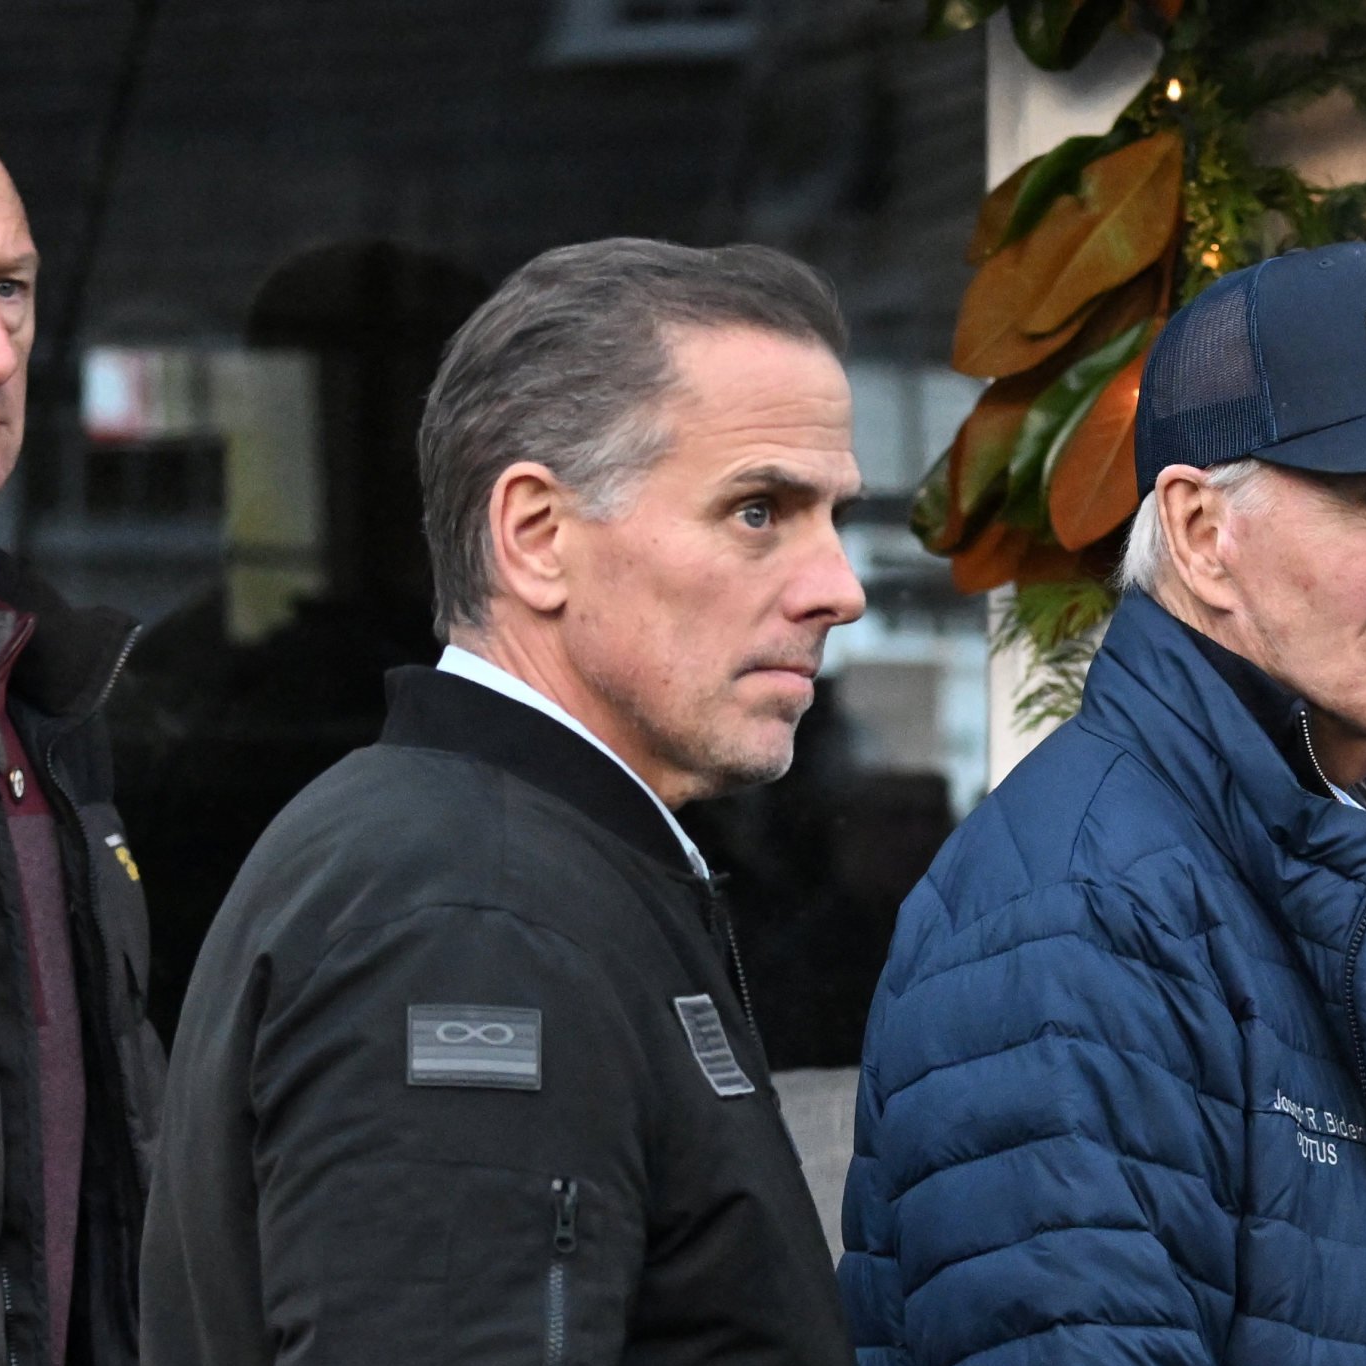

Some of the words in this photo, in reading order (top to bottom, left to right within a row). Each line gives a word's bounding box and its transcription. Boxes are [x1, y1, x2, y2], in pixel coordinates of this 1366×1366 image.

[1306, 1107, 1322, 1131] R.
[1323, 1111, 1363, 1140] Biden
[1296, 1131, 1338, 1166] POTUS
